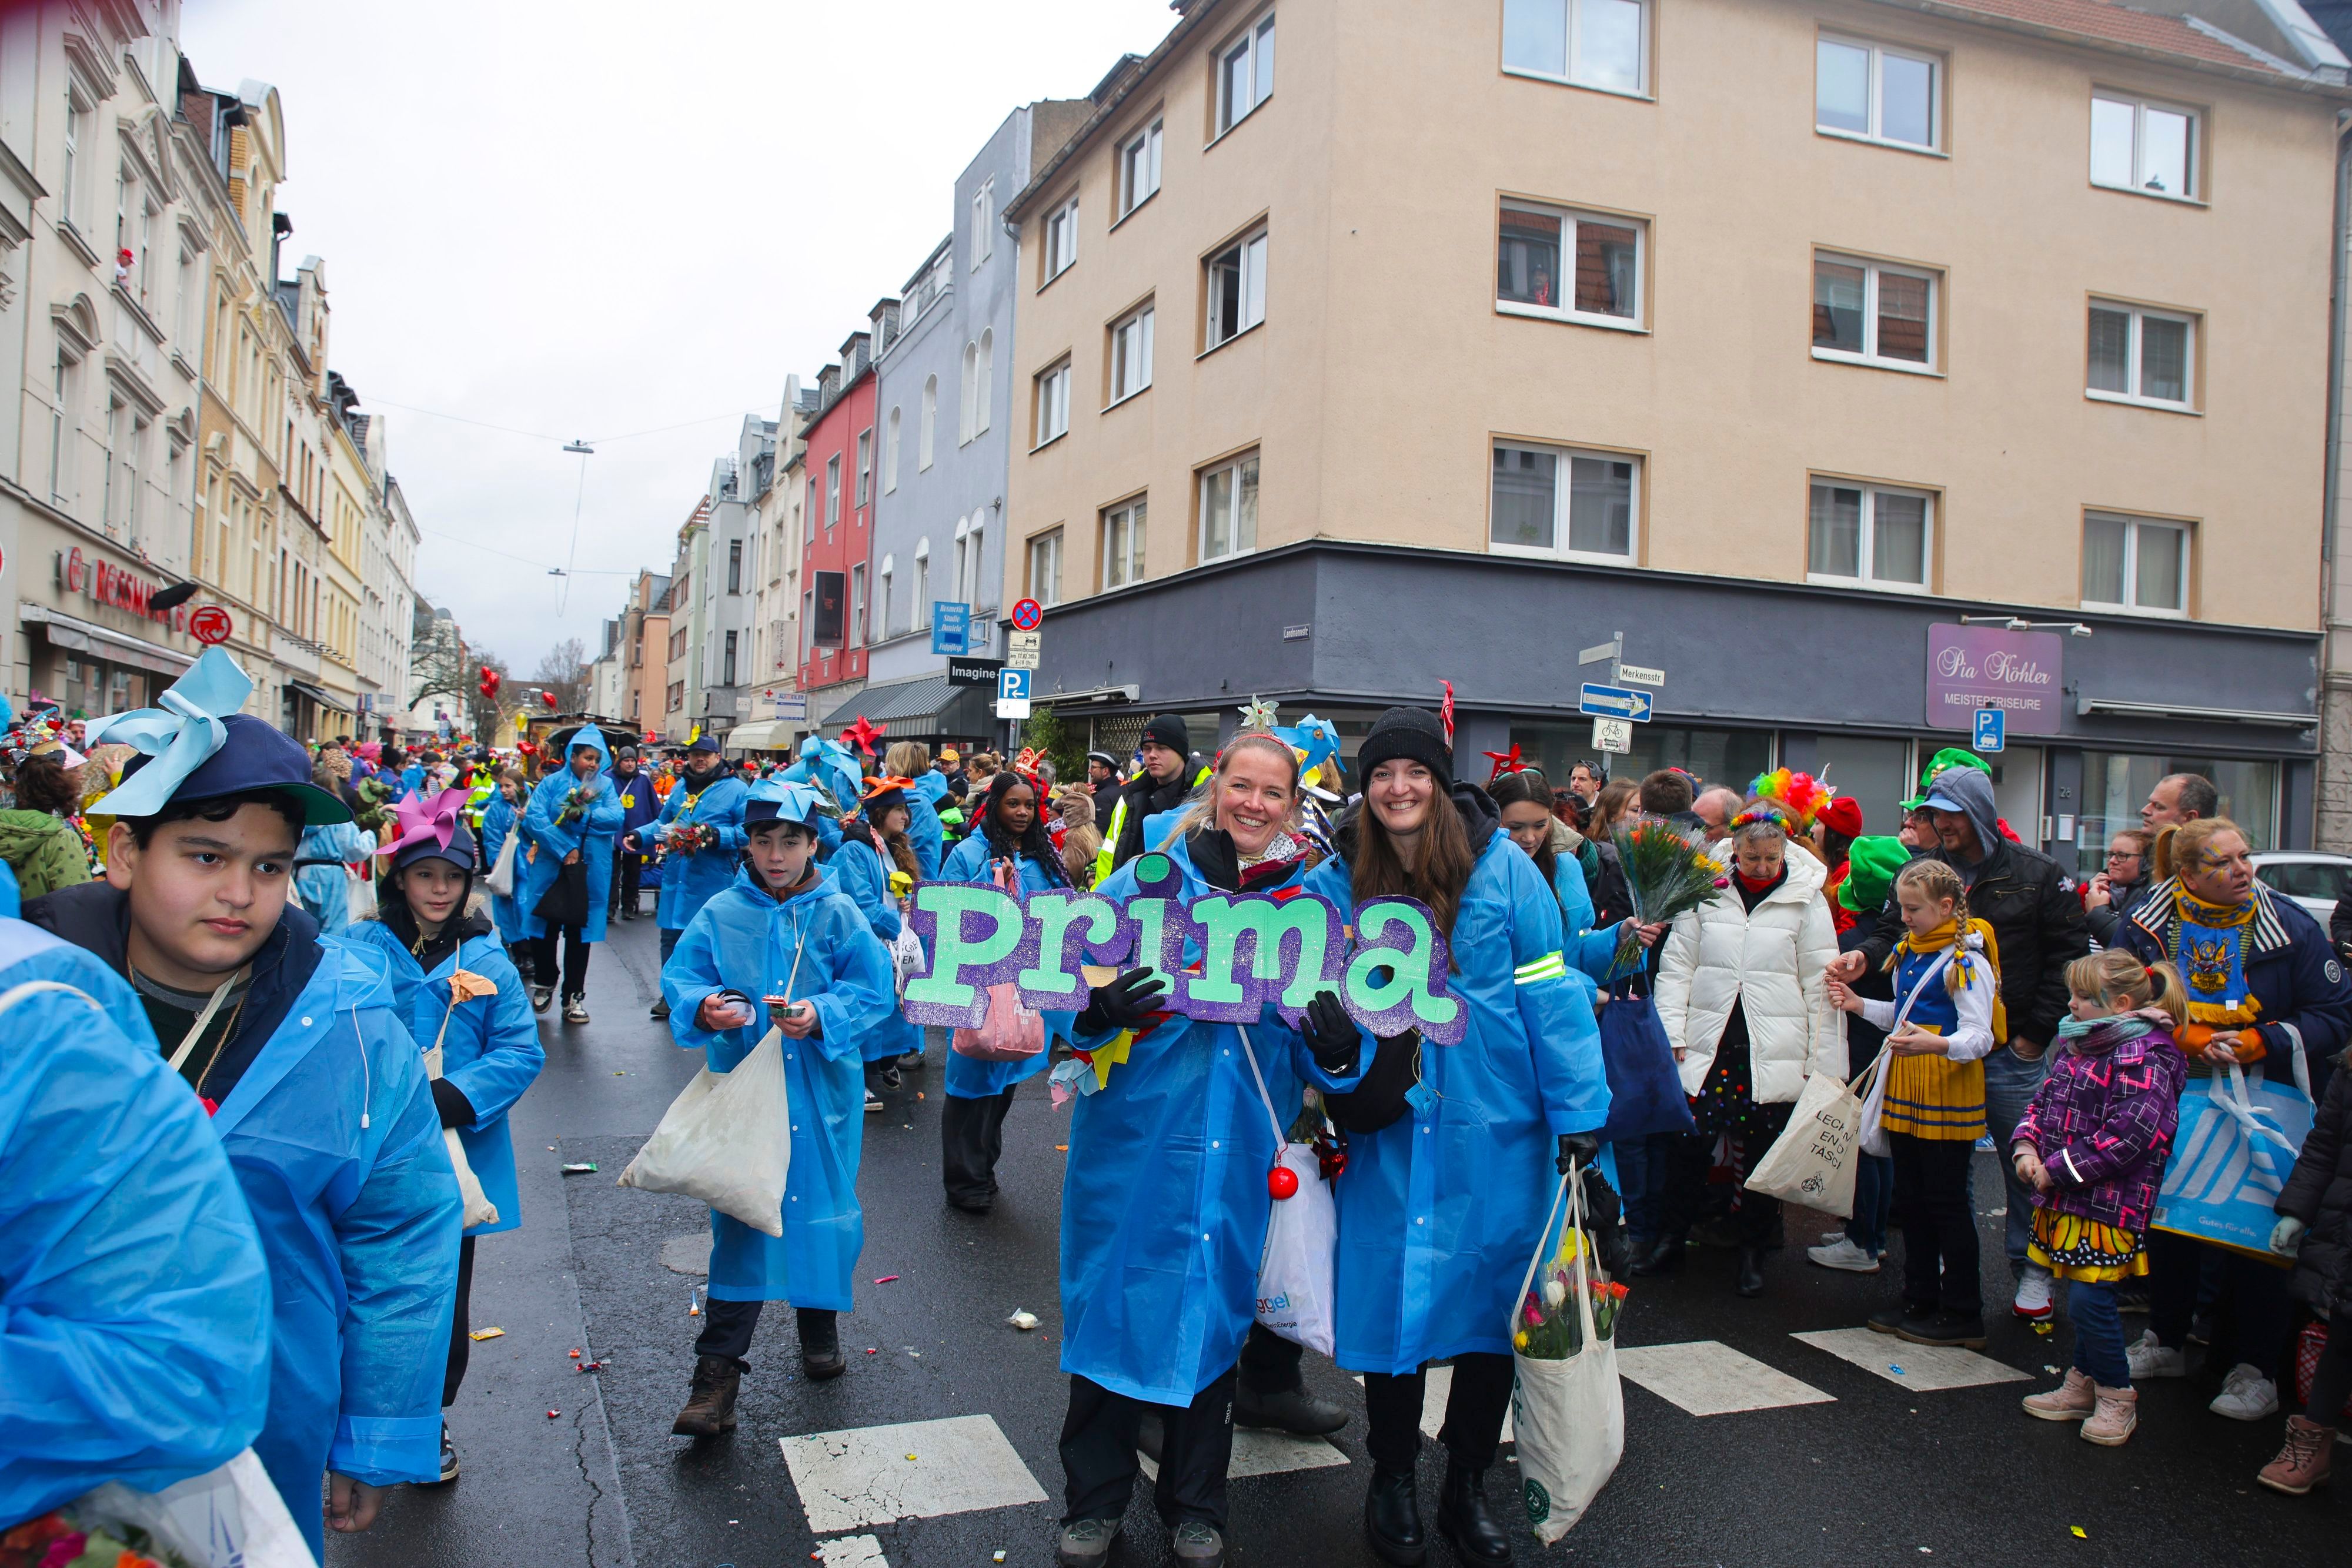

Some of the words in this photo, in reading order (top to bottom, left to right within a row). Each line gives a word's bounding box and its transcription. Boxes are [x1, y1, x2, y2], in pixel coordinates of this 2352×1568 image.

[1937, 646, 1979, 678] Pia
[1984, 651, 2051, 684] Köhler
[1622, 668, 1662, 683] Merkensstr.
[1004, 673, 1021, 698] P
[1979, 713, 1993, 731] P
[2199, 1216, 2223, 1229] Gutes
[2225, 1222, 2239, 1232] für
[2240, 1227, 2257, 1237] alle.
[1528, 1491, 1539, 1507] 75
